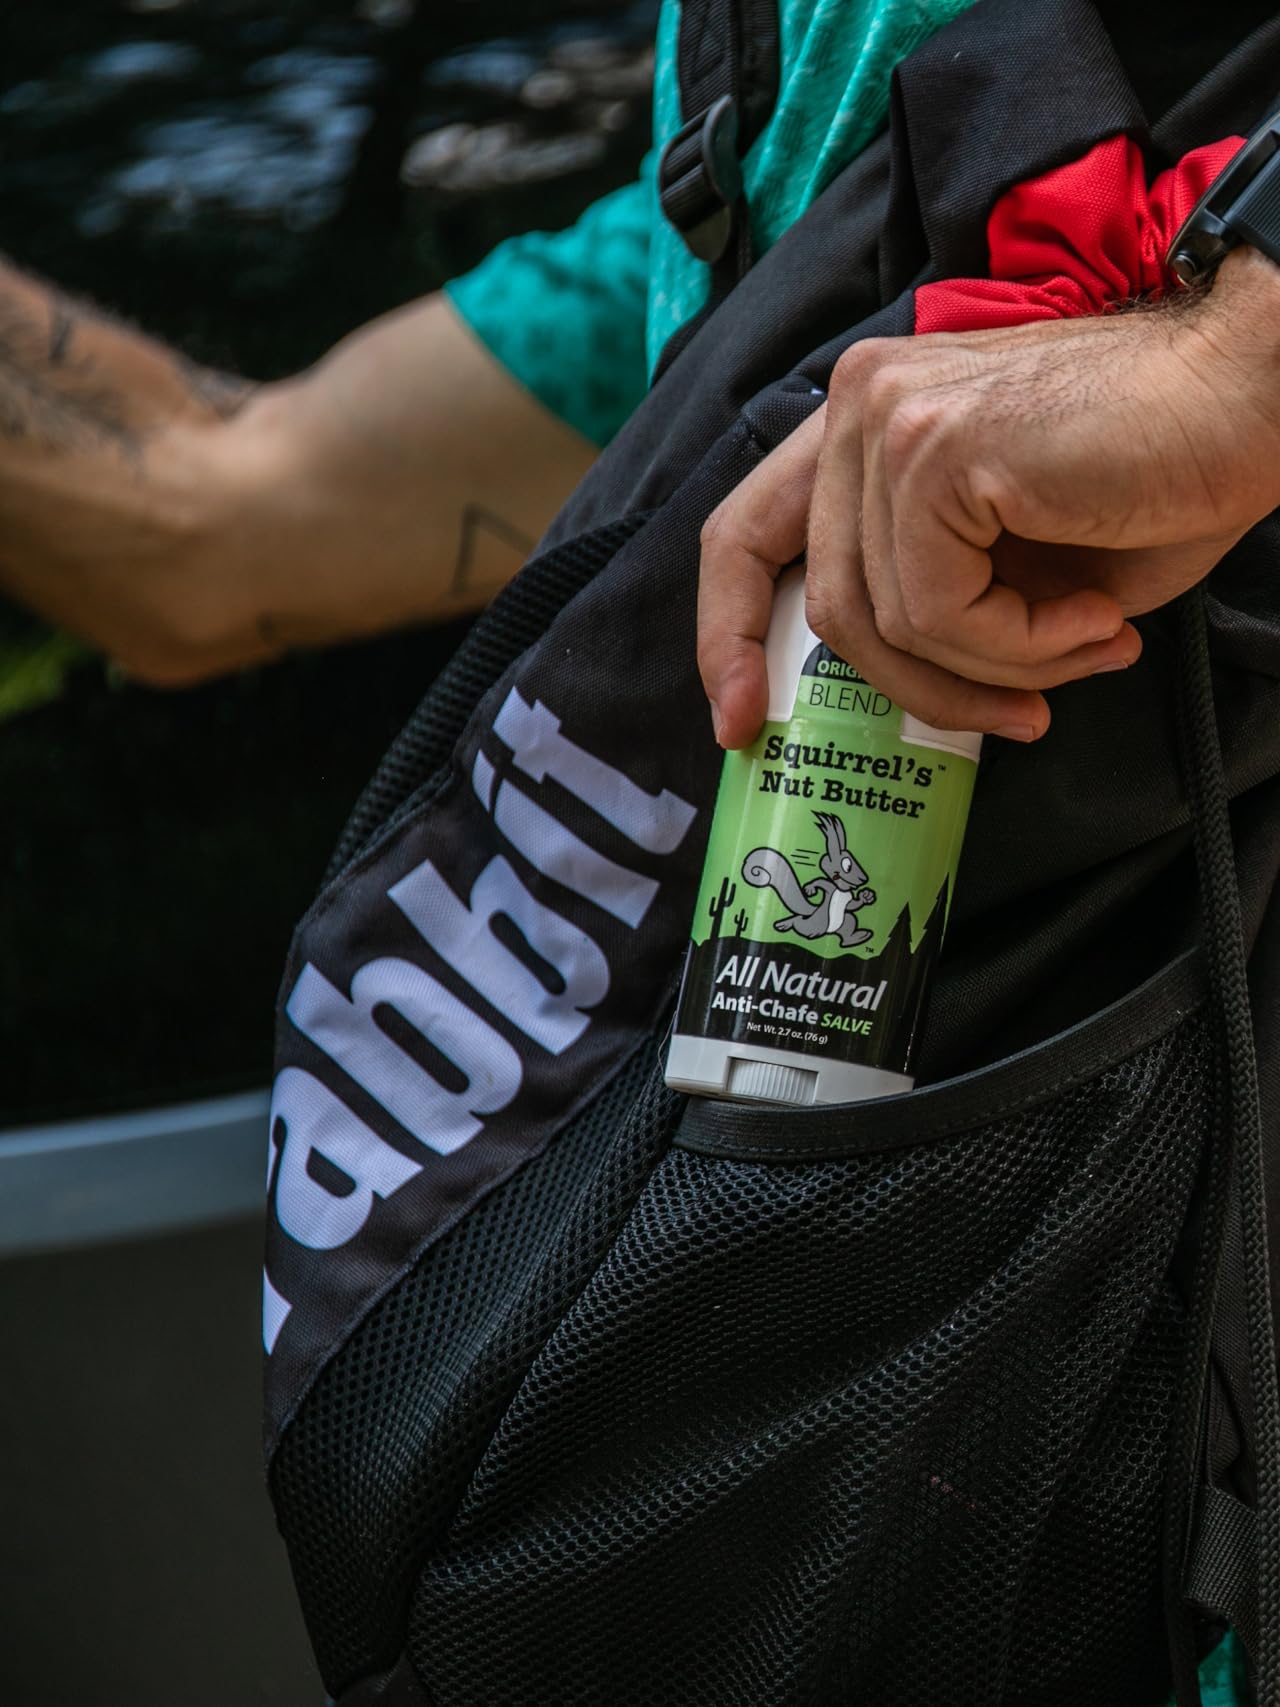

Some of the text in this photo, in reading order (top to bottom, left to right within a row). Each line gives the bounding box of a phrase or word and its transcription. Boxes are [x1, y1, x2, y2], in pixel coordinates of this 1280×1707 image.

[816, 659, 862, 680] ORIG
[809, 683, 892, 716] BLEND
[764, 735, 932, 788] Squirrel's
[758, 770, 926, 819] Nut Butter
[715, 955, 888, 1012] All Natural
[262, 686, 697, 1356] abbit
[711, 991, 873, 1036] Anti-Chafe SALVE
[746, 1021, 829, 1045] Net Wt. 2.7 oz. (76 g)
